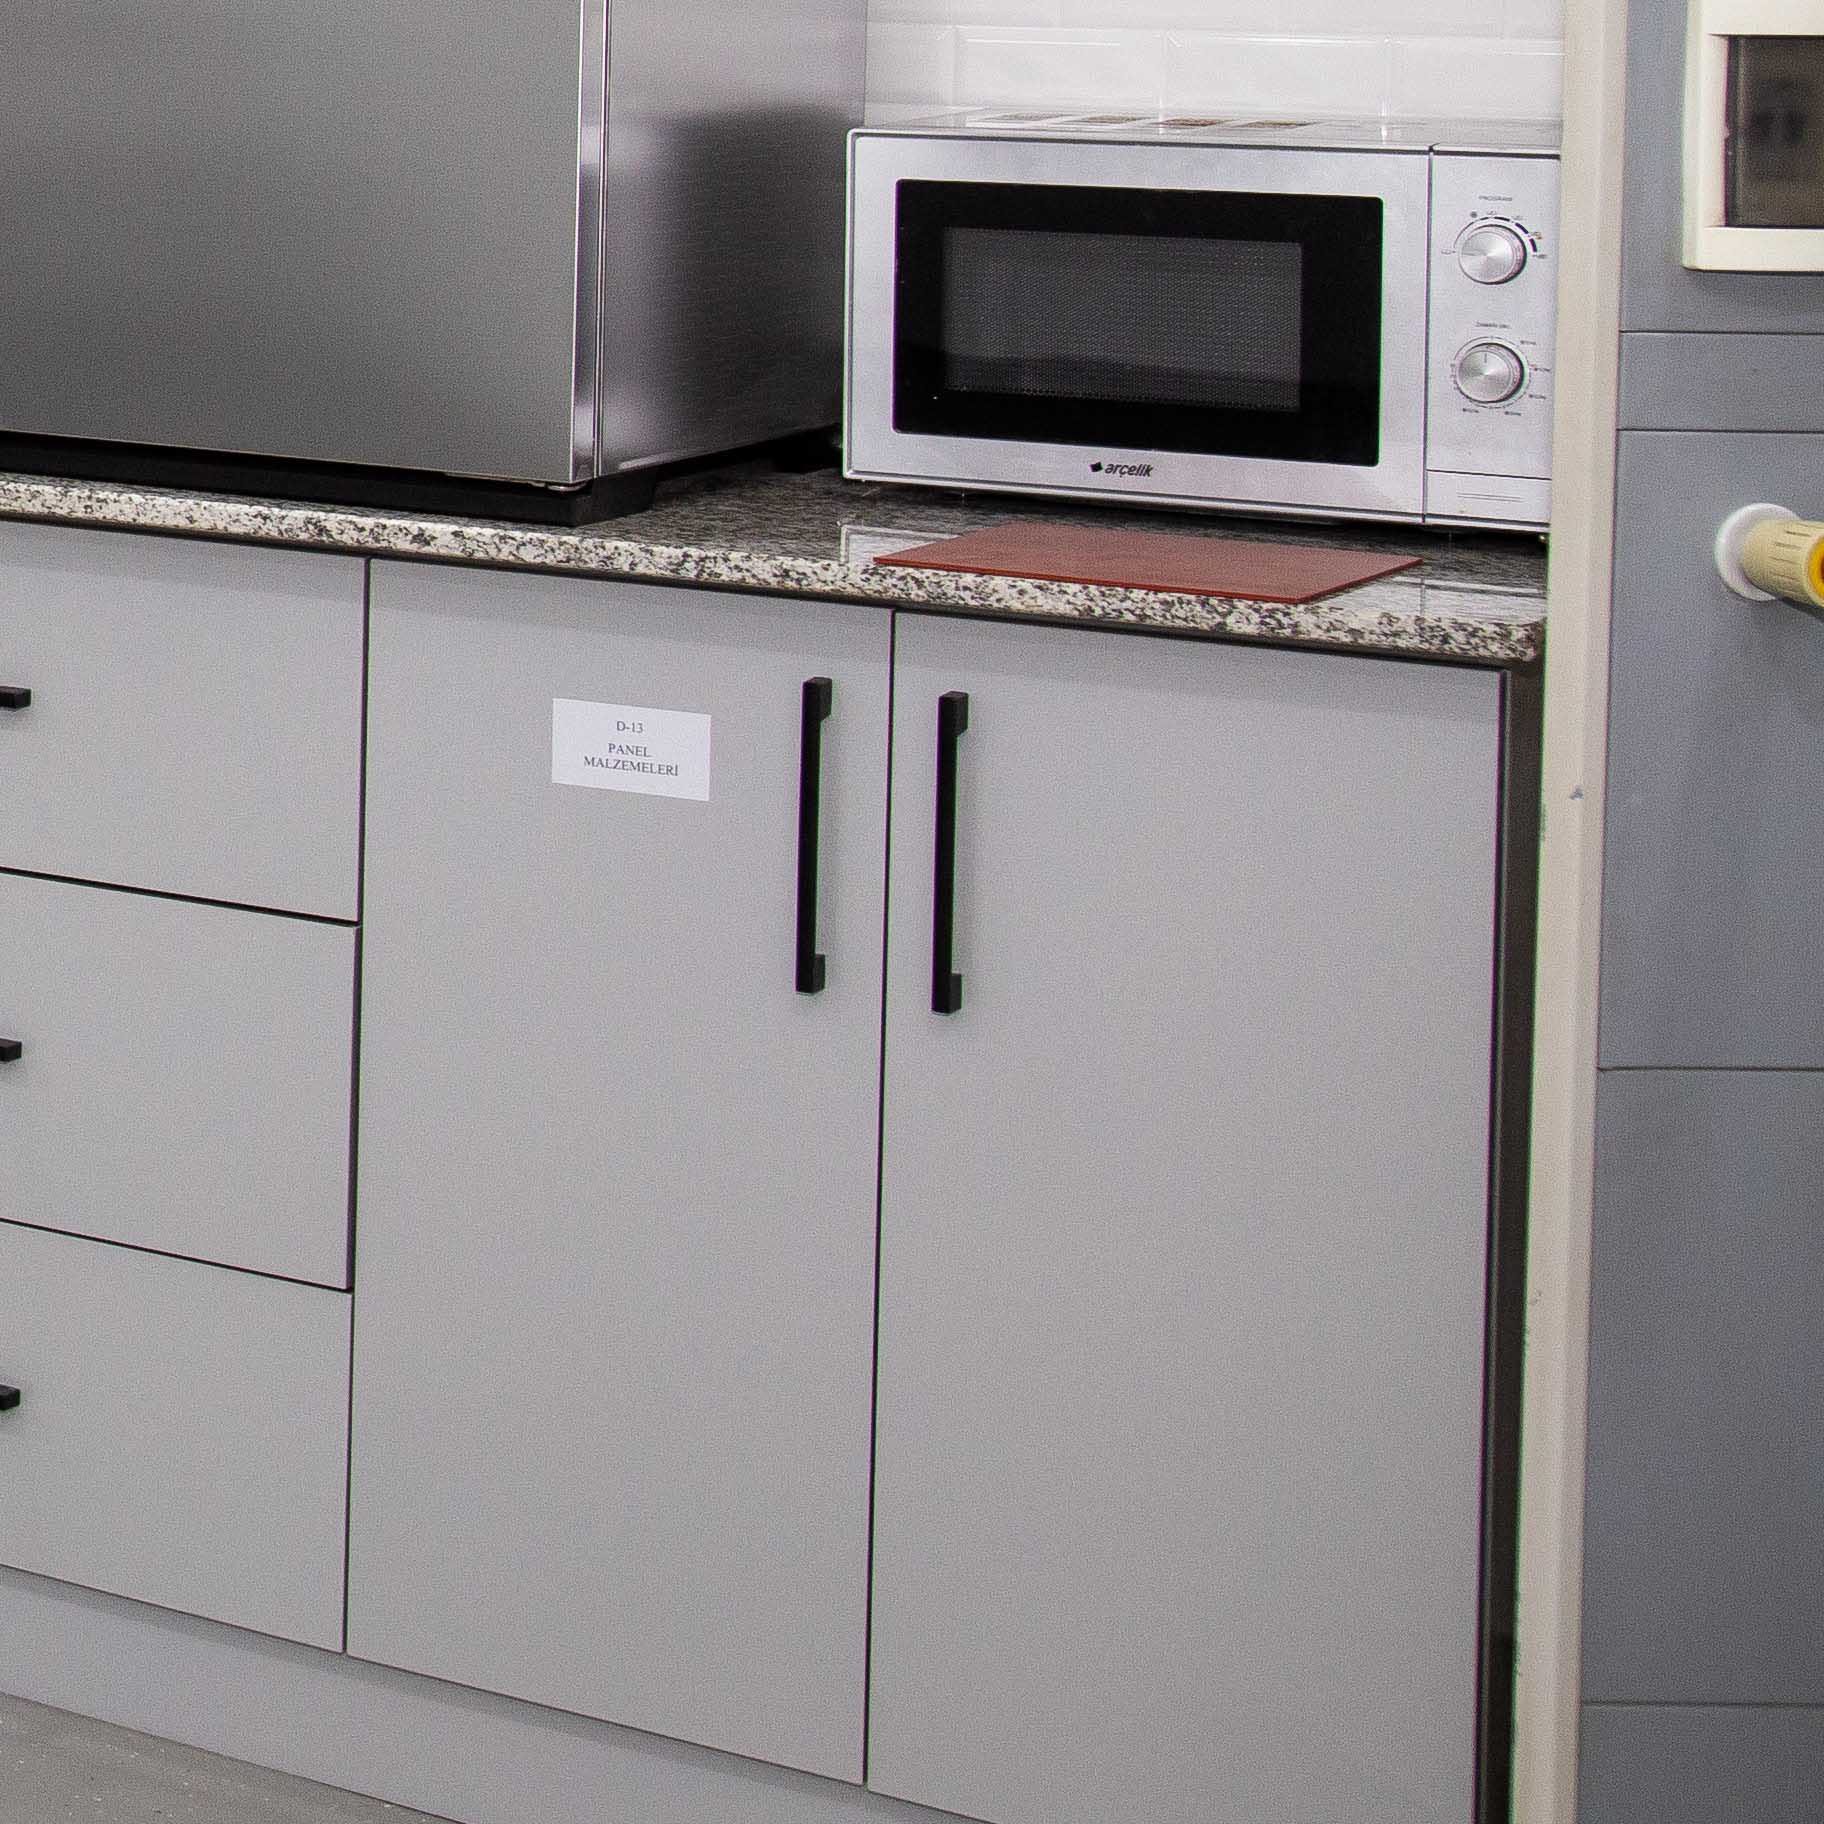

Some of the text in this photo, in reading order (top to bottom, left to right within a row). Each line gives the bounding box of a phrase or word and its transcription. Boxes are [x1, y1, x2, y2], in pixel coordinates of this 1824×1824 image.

[1104, 463, 1153, 478] arçelik
[616, 721, 644, 733] D-13
[608, 743, 652, 758] PANEL
[583, 756, 679, 777] MALZEMELERİ
